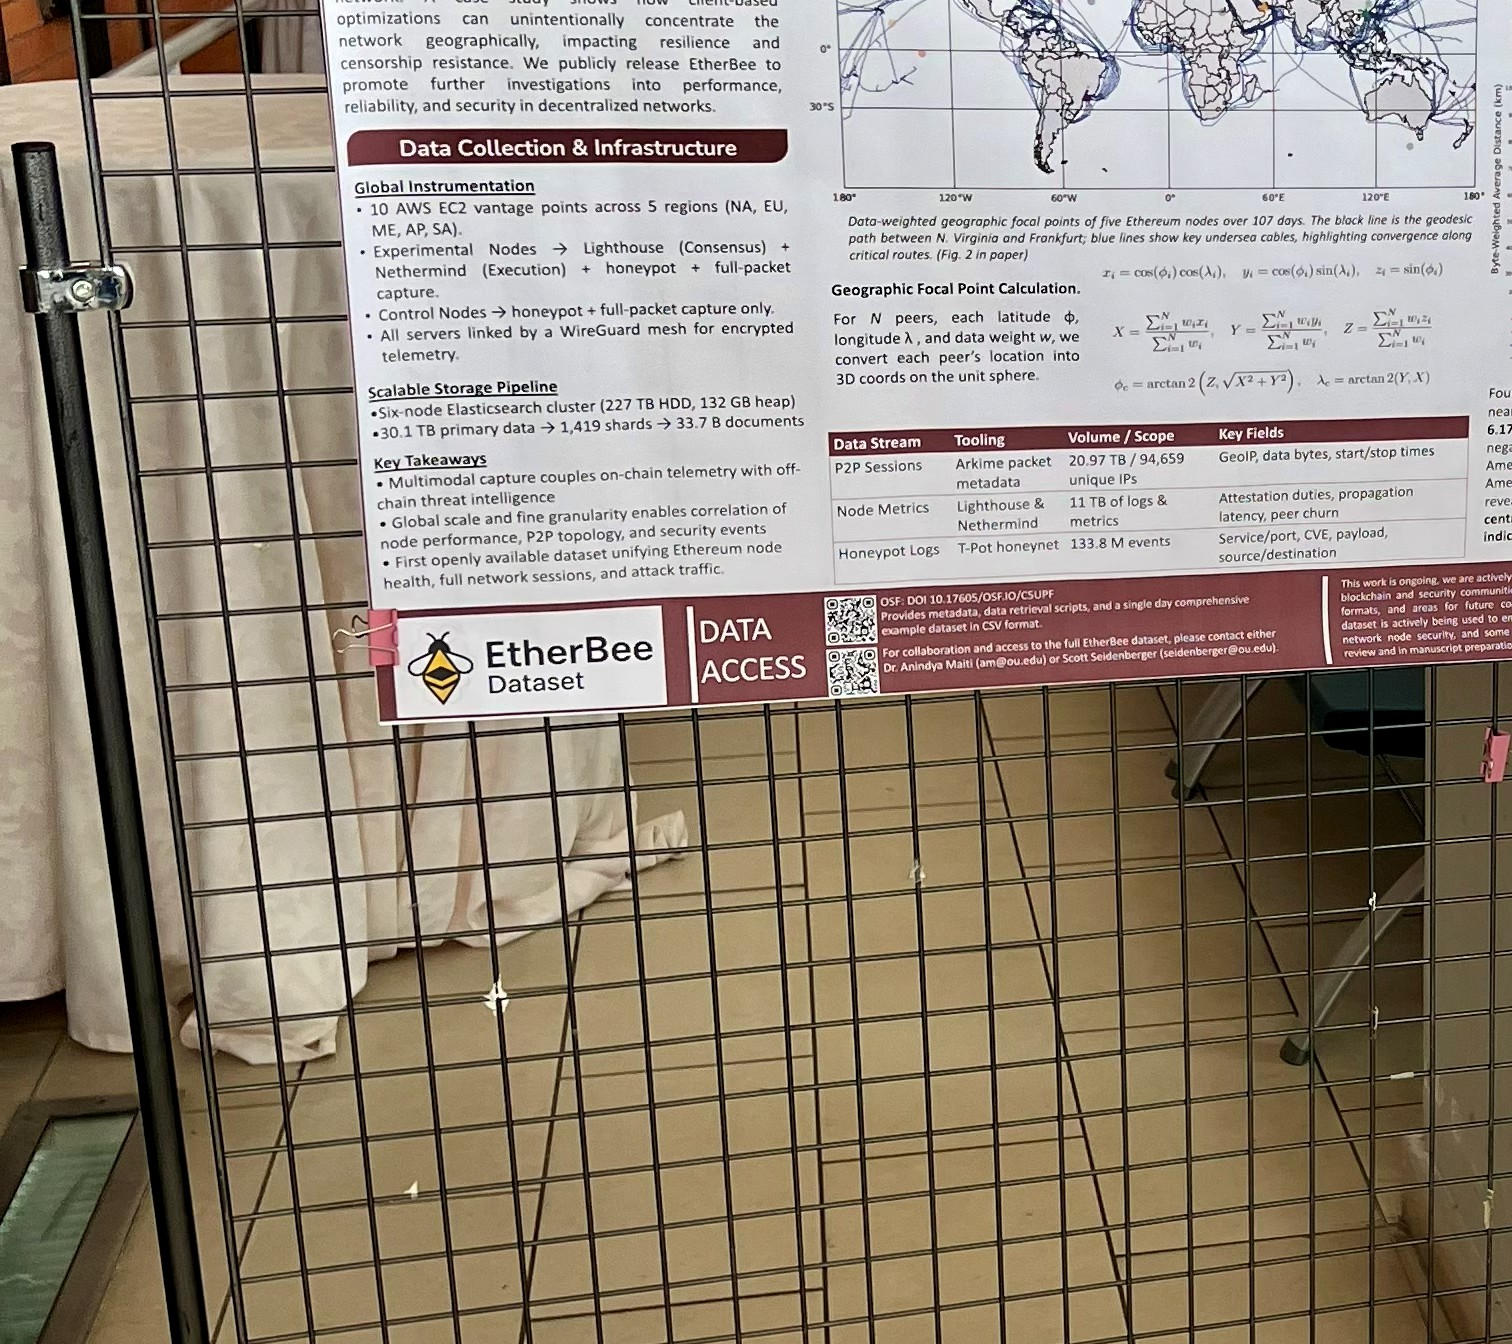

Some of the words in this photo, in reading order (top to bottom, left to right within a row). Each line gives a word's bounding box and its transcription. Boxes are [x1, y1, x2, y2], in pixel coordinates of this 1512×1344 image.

[820, 45, 830, 53] 0°
[809, 102, 834, 111] 30°S
[399, 139, 451, 157] Data
[457, 138, 565, 156] Collection
[572, 138, 588, 156] &
[594, 138, 737, 156] Infrastructure
[355, 179, 404, 194] Global
[408, 178, 535, 193] Instrumentation
[833, 193, 856, 202] 180°
[939, 193, 972, 202] 120°W
[1051, 193, 1077, 202] 60°W
[1165, 193, 1175, 202] 0°
[1262, 193, 1284, 202] 60°E
[1362, 193, 1389, 202] 120°E
[1464, 192, 1484, 202] 180°
[831, 282, 913, 298] Geographic
[917, 282, 953, 295] Focal
[958, 282, 995, 294] Point
[998, 281, 1080, 294] Calculation.
[368, 382, 430, 399] Scalable
[435, 380, 492, 397] Storage
[497, 379, 558, 396] Pipeline
[953, 433, 1005, 448] Tooling
[1067, 431, 1120, 443] Volume
[1134, 430, 1174, 444] Scope
[1219, 428, 1243, 442] Key
[1246, 426, 1284, 439] Fields
[834, 437, 865, 451] Data
[871, 436, 922, 450] Stream
[374, 454, 400, 471] Key
[404, 453, 487, 468] Takeaways
[880, 596, 905, 607] OSF:
[907, 595, 927, 605] DOI
[700, 617, 771, 643] DATA
[486, 636, 654, 668] EtherBee
[701, 656, 806, 684] ACCESS
[488, 674, 584, 695] Dataset
